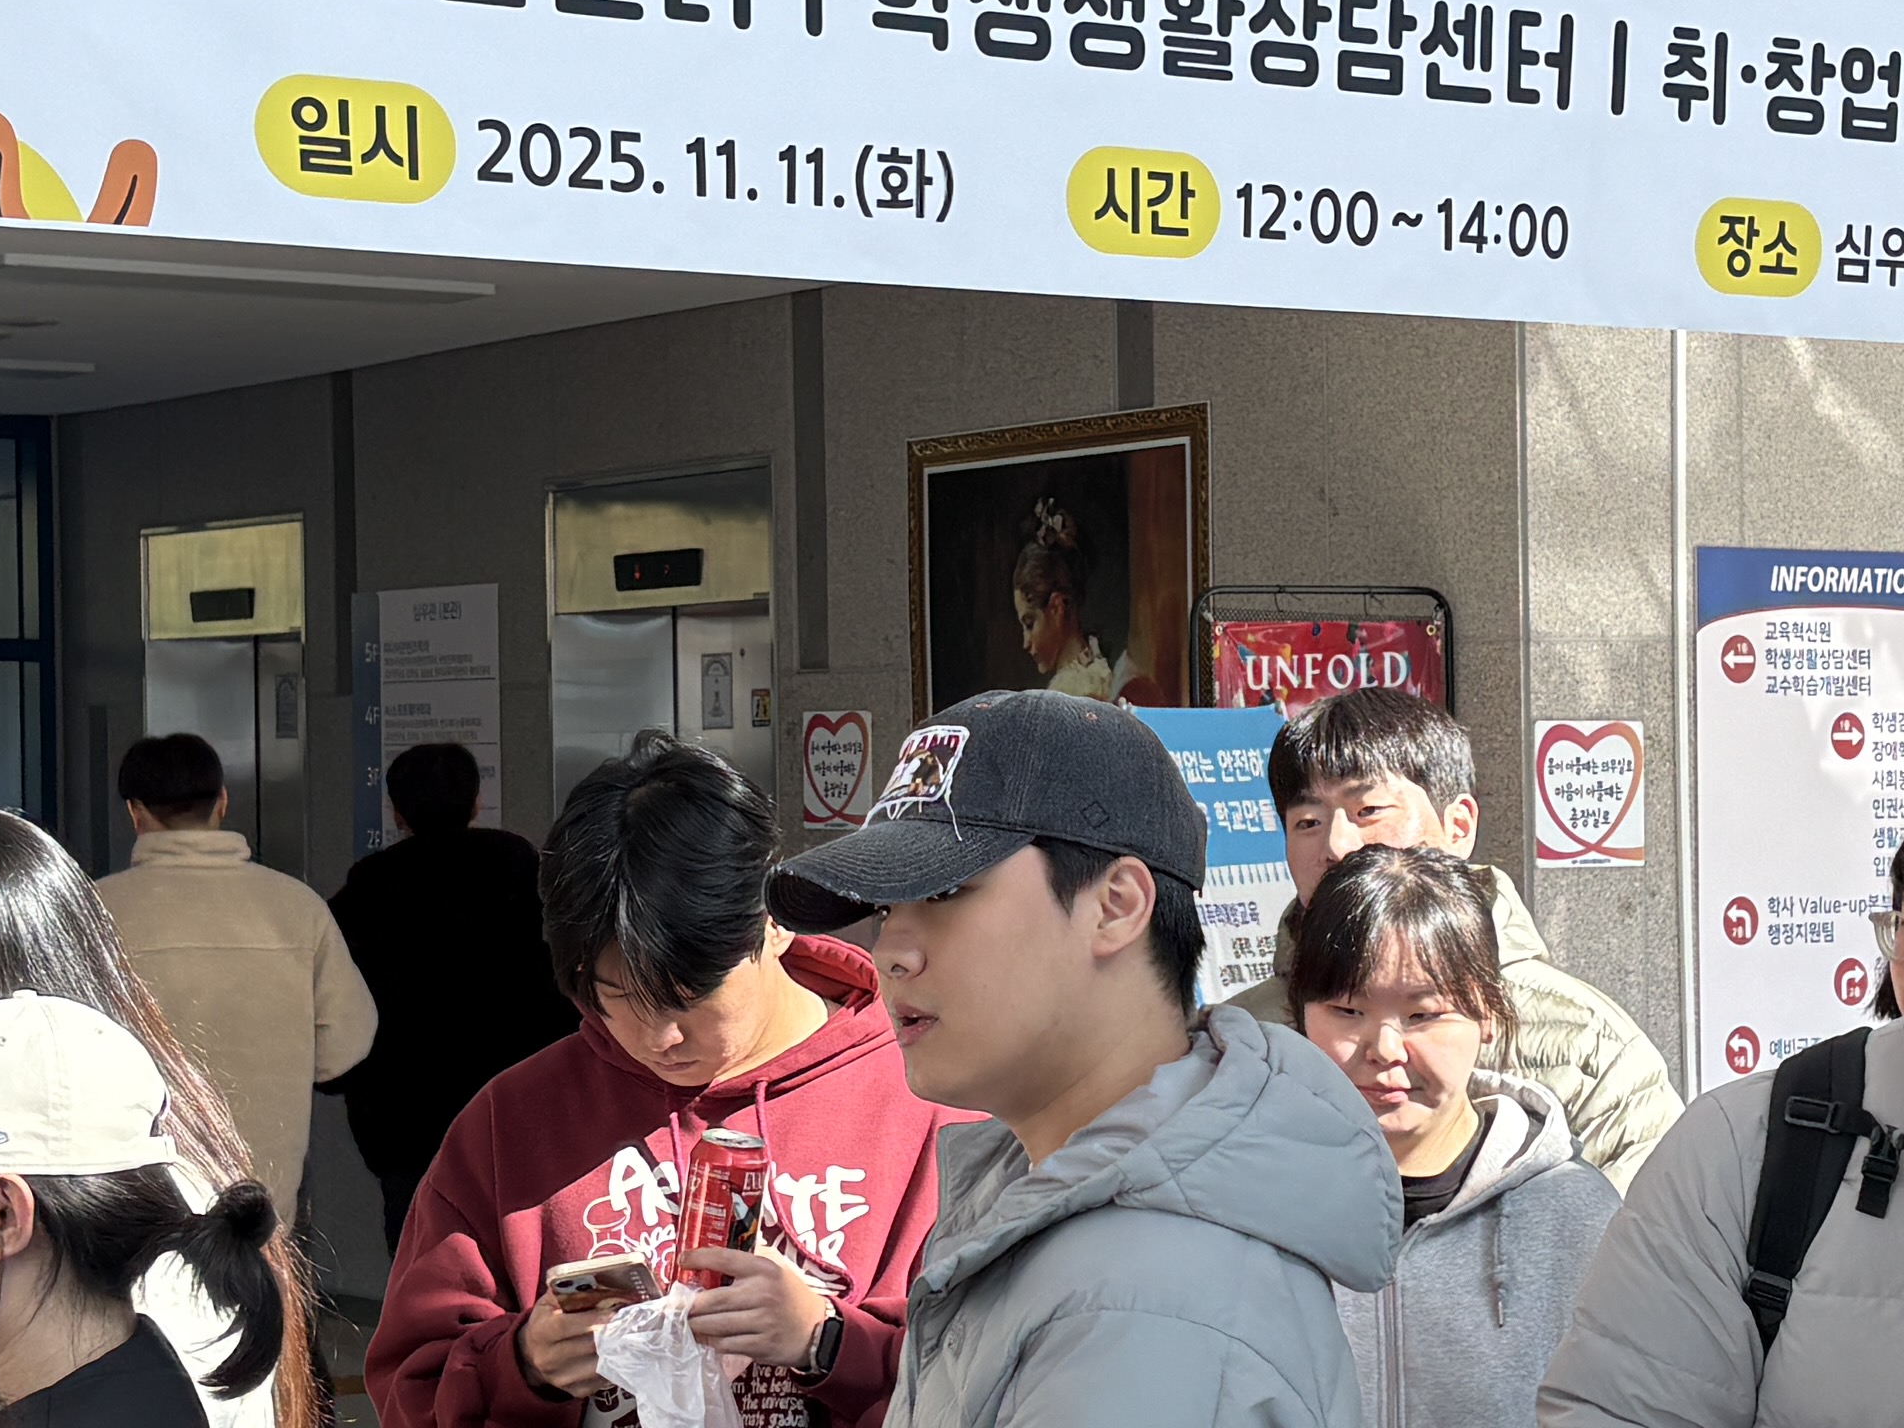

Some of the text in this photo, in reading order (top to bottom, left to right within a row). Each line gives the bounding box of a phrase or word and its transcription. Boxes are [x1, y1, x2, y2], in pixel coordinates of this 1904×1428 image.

[290, 95, 420, 182] 일시
[1093, 166, 1197, 238] 시간
[1716, 214, 1799, 279] 장소
[1763, 620, 1832, 644] 교육혁신원
[1244, 650, 1410, 691] UNFOLD
[1763, 647, 1873, 671] 학생생활상담센터
[1763, 674, 1873, 698] 교수학습개발센터
[1554, 780, 1625, 803] 마음이 아플때는
[1568, 807, 1611, 830] 총장실로
[1767, 895, 1795, 919] 학사
[1766, 920, 1836, 946] 행정지원팀
